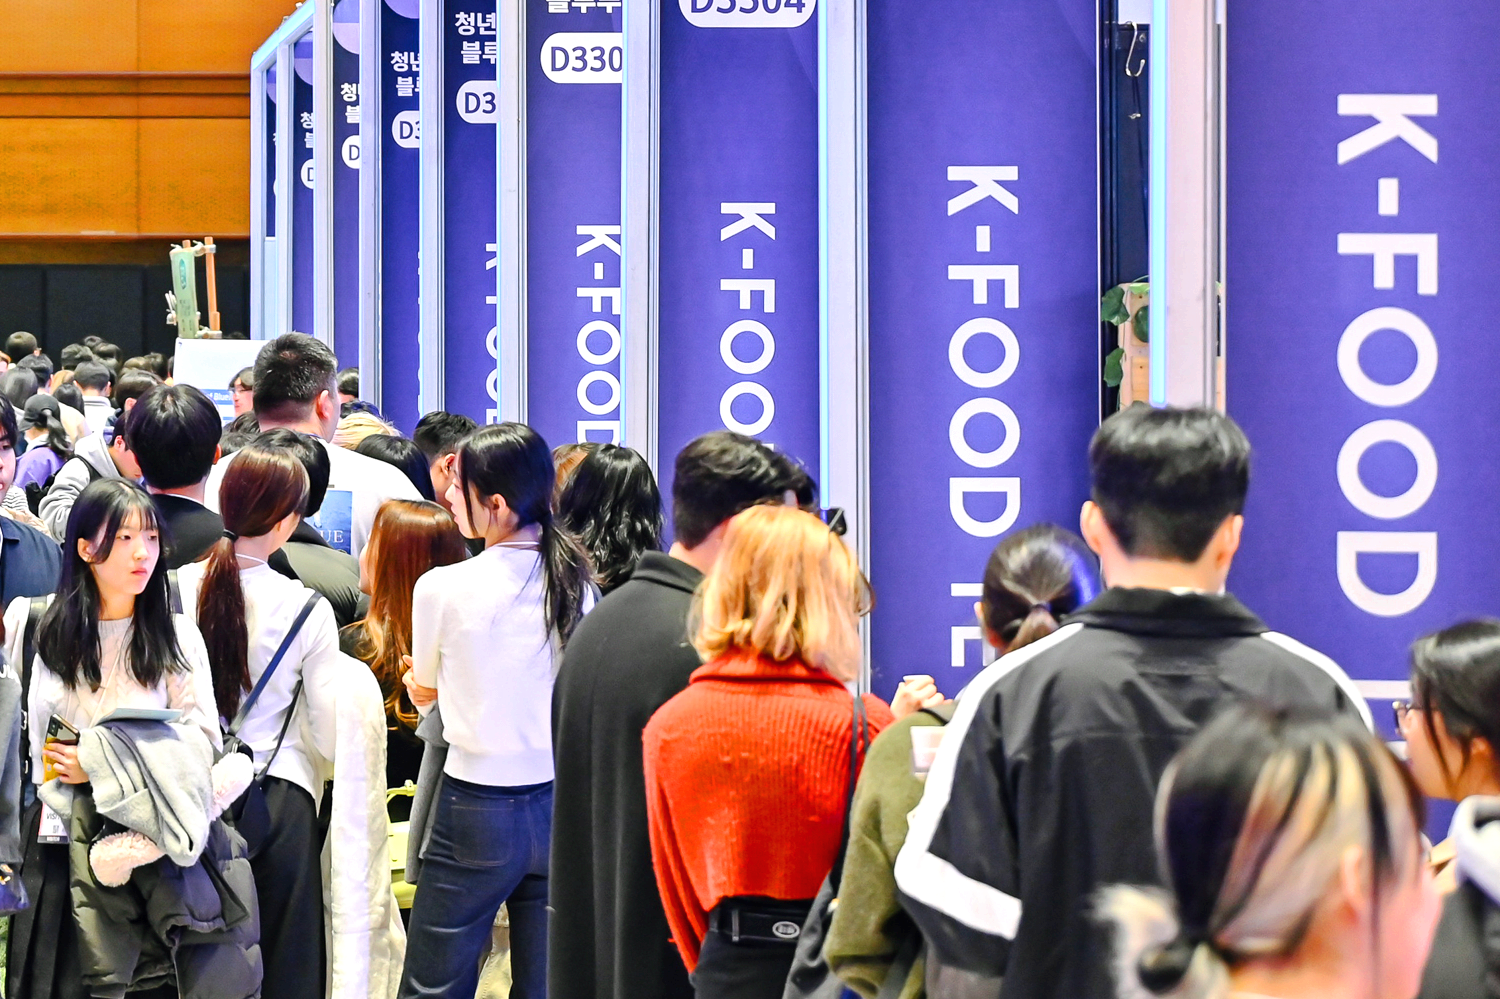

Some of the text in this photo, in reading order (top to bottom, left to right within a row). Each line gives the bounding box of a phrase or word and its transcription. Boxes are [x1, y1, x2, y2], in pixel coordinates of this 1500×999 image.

[719, 202, 776, 451] K-FOO
[946, 165, 1021, 538] K-FOOD
[1336, 93, 1439, 618] K-FOOD
